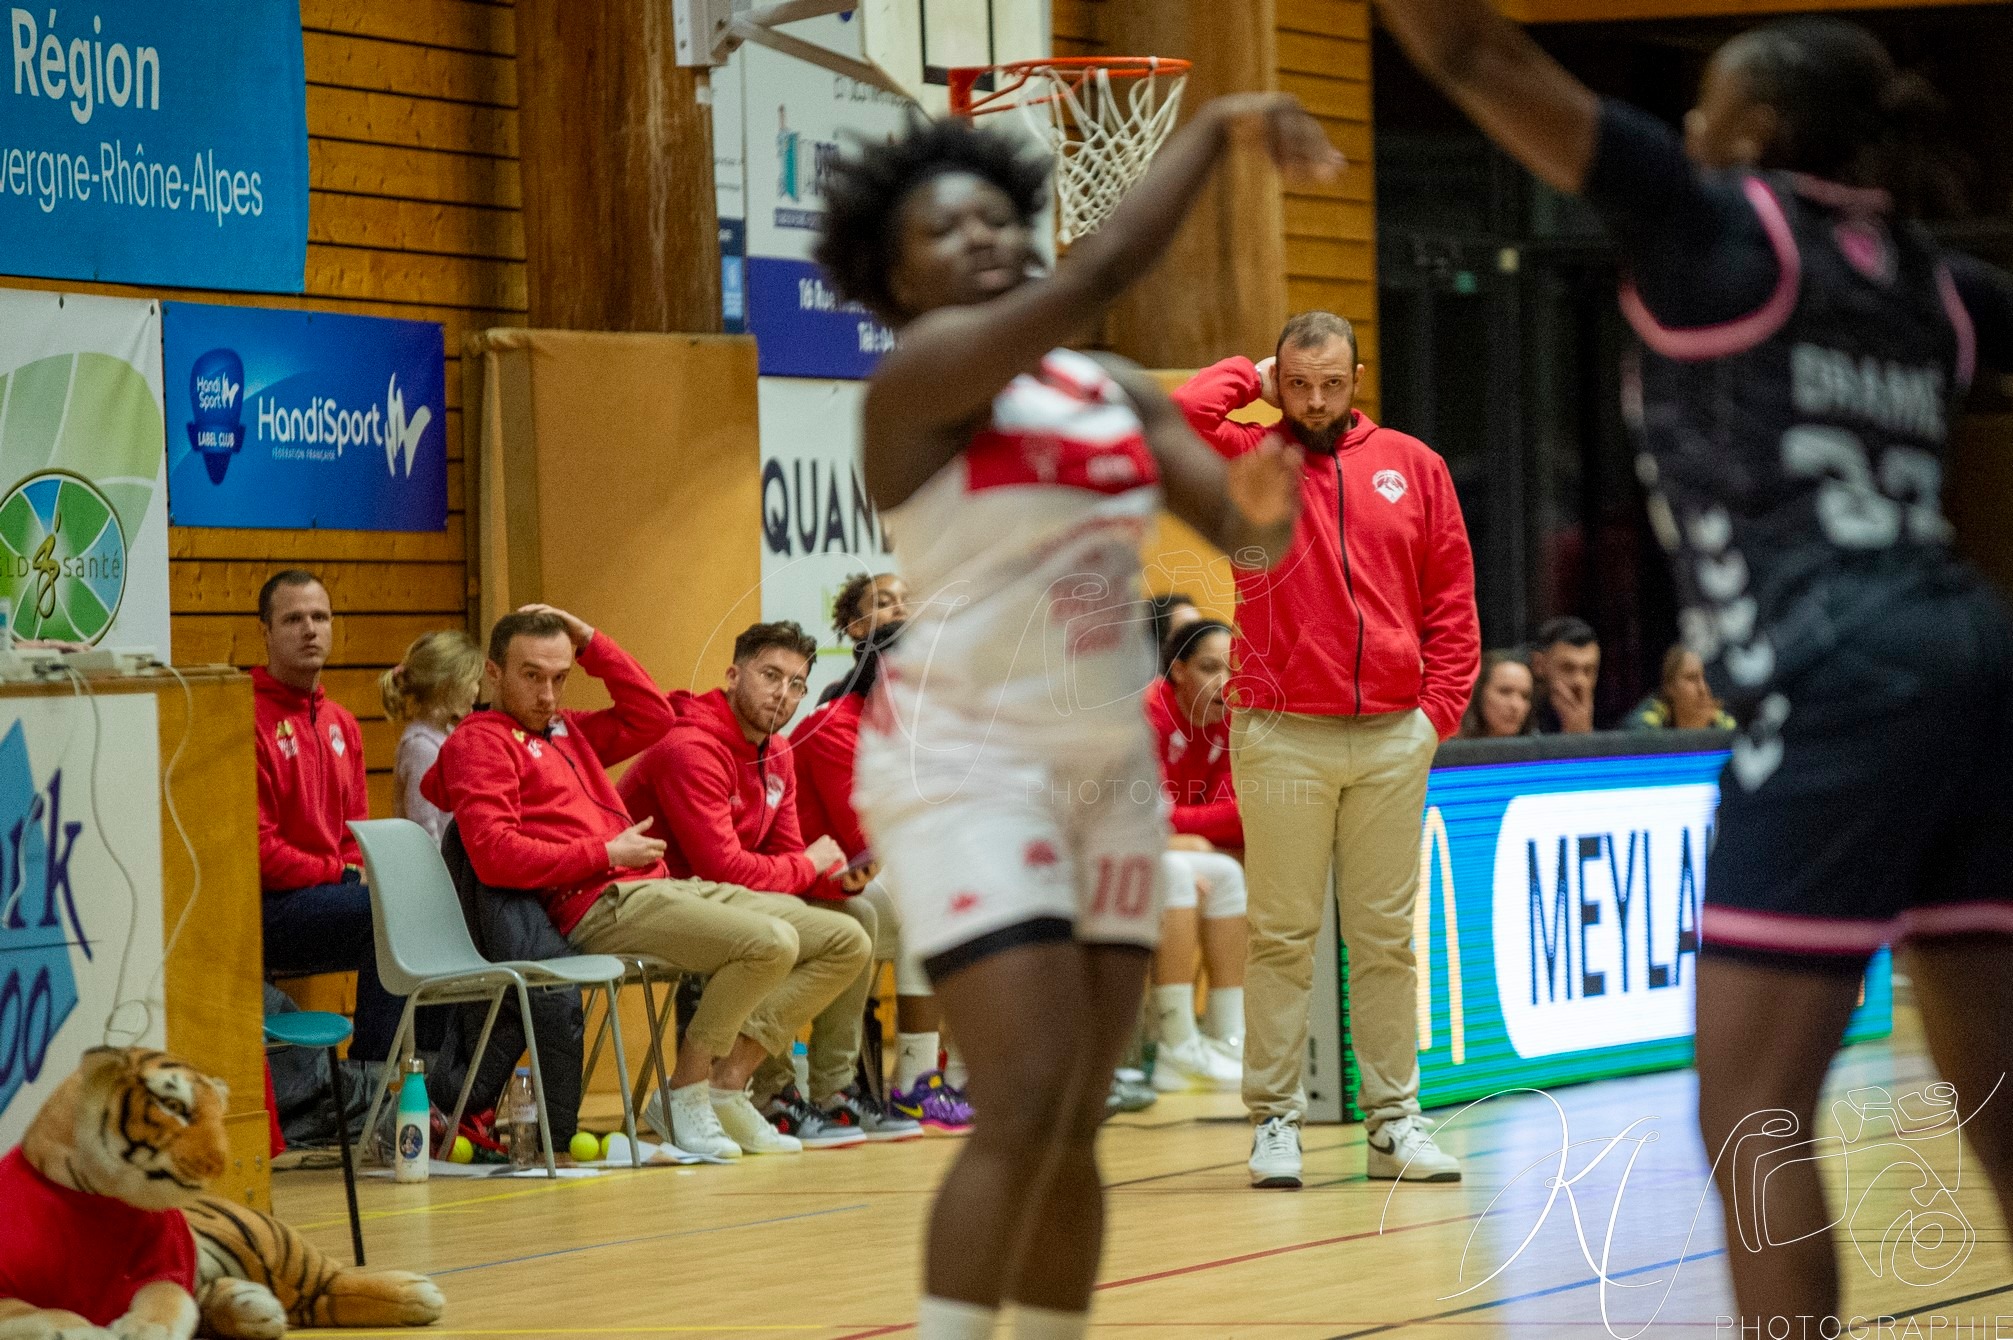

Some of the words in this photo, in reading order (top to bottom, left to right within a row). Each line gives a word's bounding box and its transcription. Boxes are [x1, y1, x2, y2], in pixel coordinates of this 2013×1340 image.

[11, 8, 160, 124] Région
[196, 376, 221, 393] Handi
[199, 391, 221, 413] Sport
[198, 431, 217, 447] LABEL
[219, 432, 235, 448] CLUB
[258, 396, 383, 458] HandiSport
[63, 551, 120, 579] santé
[1093, 852, 1152, 920] 10
[1527, 825, 1713, 1006] MEYLA
